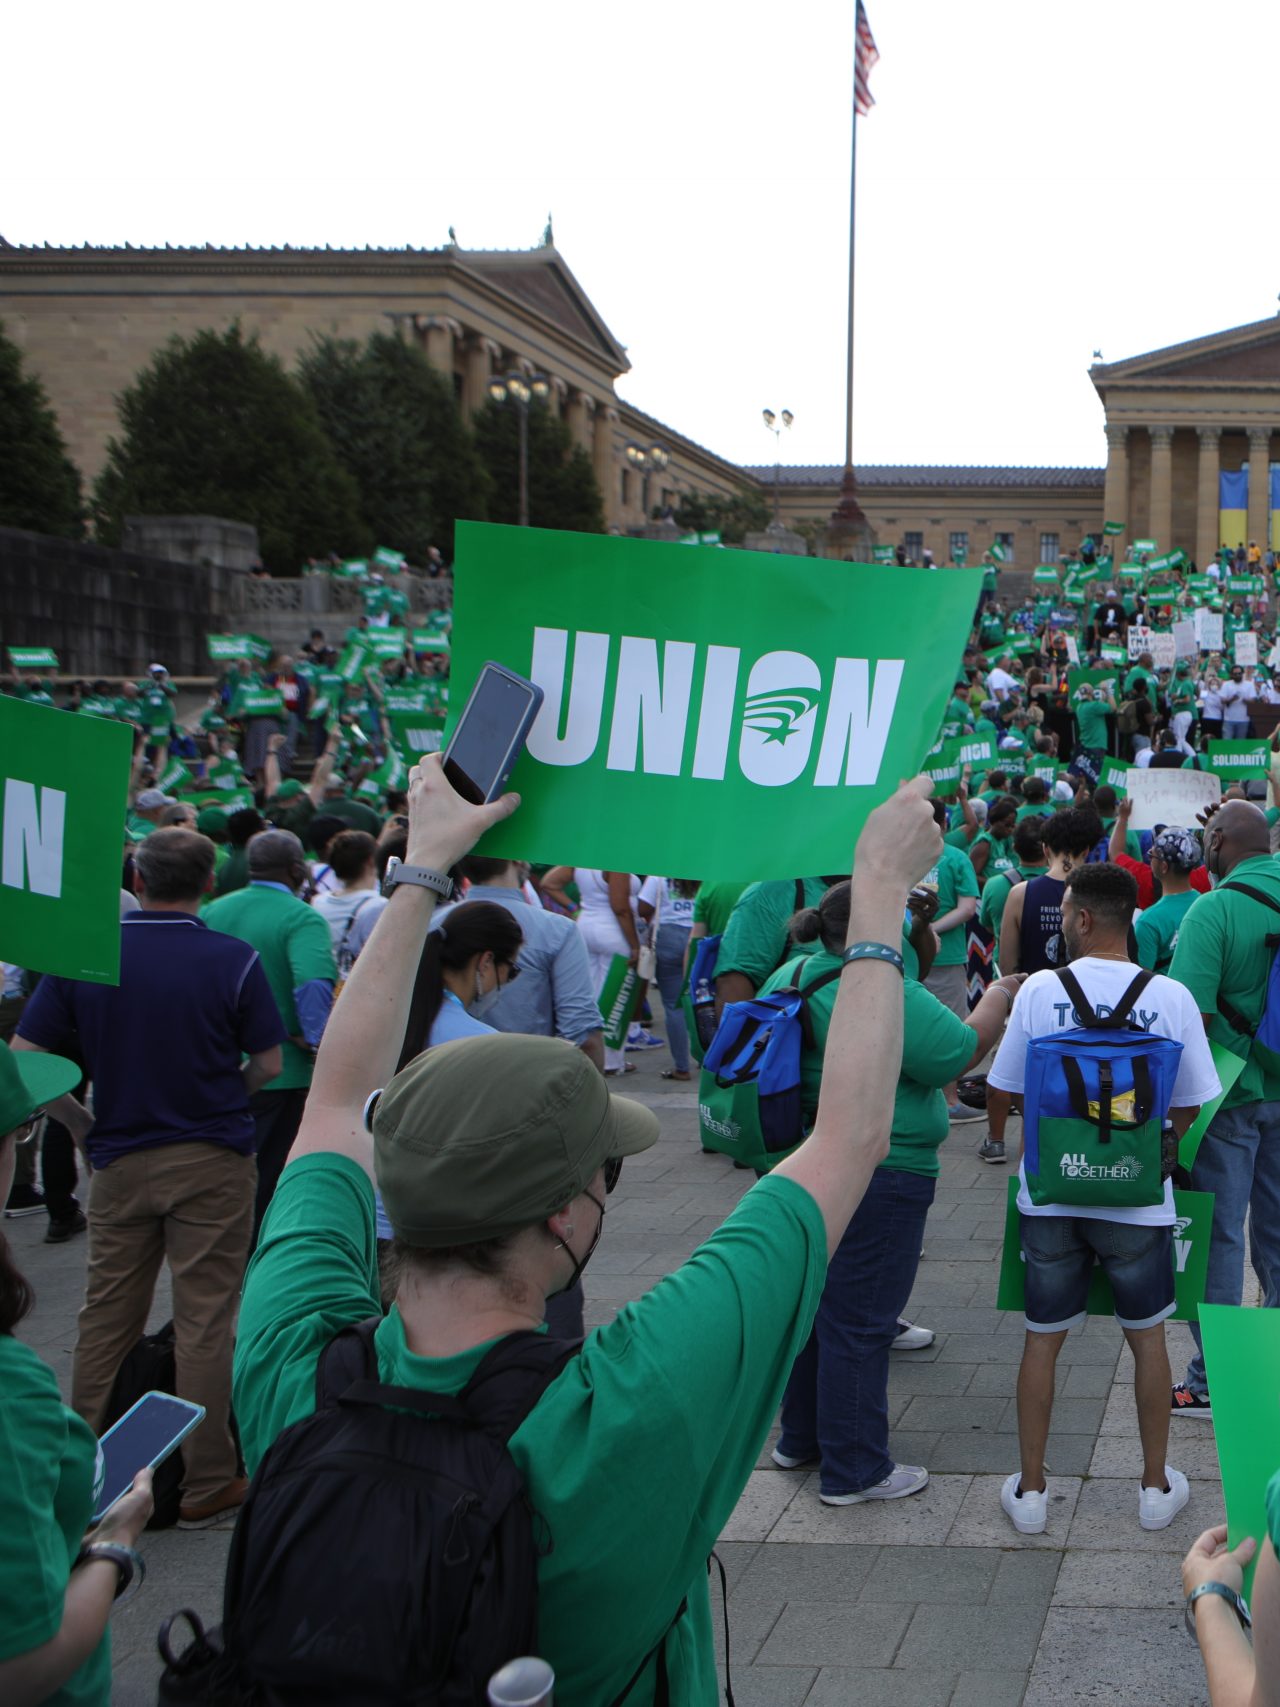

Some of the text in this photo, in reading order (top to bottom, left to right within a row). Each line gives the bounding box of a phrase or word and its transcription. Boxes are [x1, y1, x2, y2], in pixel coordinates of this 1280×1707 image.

[525, 626, 905, 787] UNION
[1212, 754, 1267, 767] SOLIDARITY
[1040, 914, 1061, 922] DEVO
[1040, 923, 1062, 931] STRE
[1060, 1153, 1088, 1166] ALL
[1060, 1163, 1130, 1179] TOGETHER
